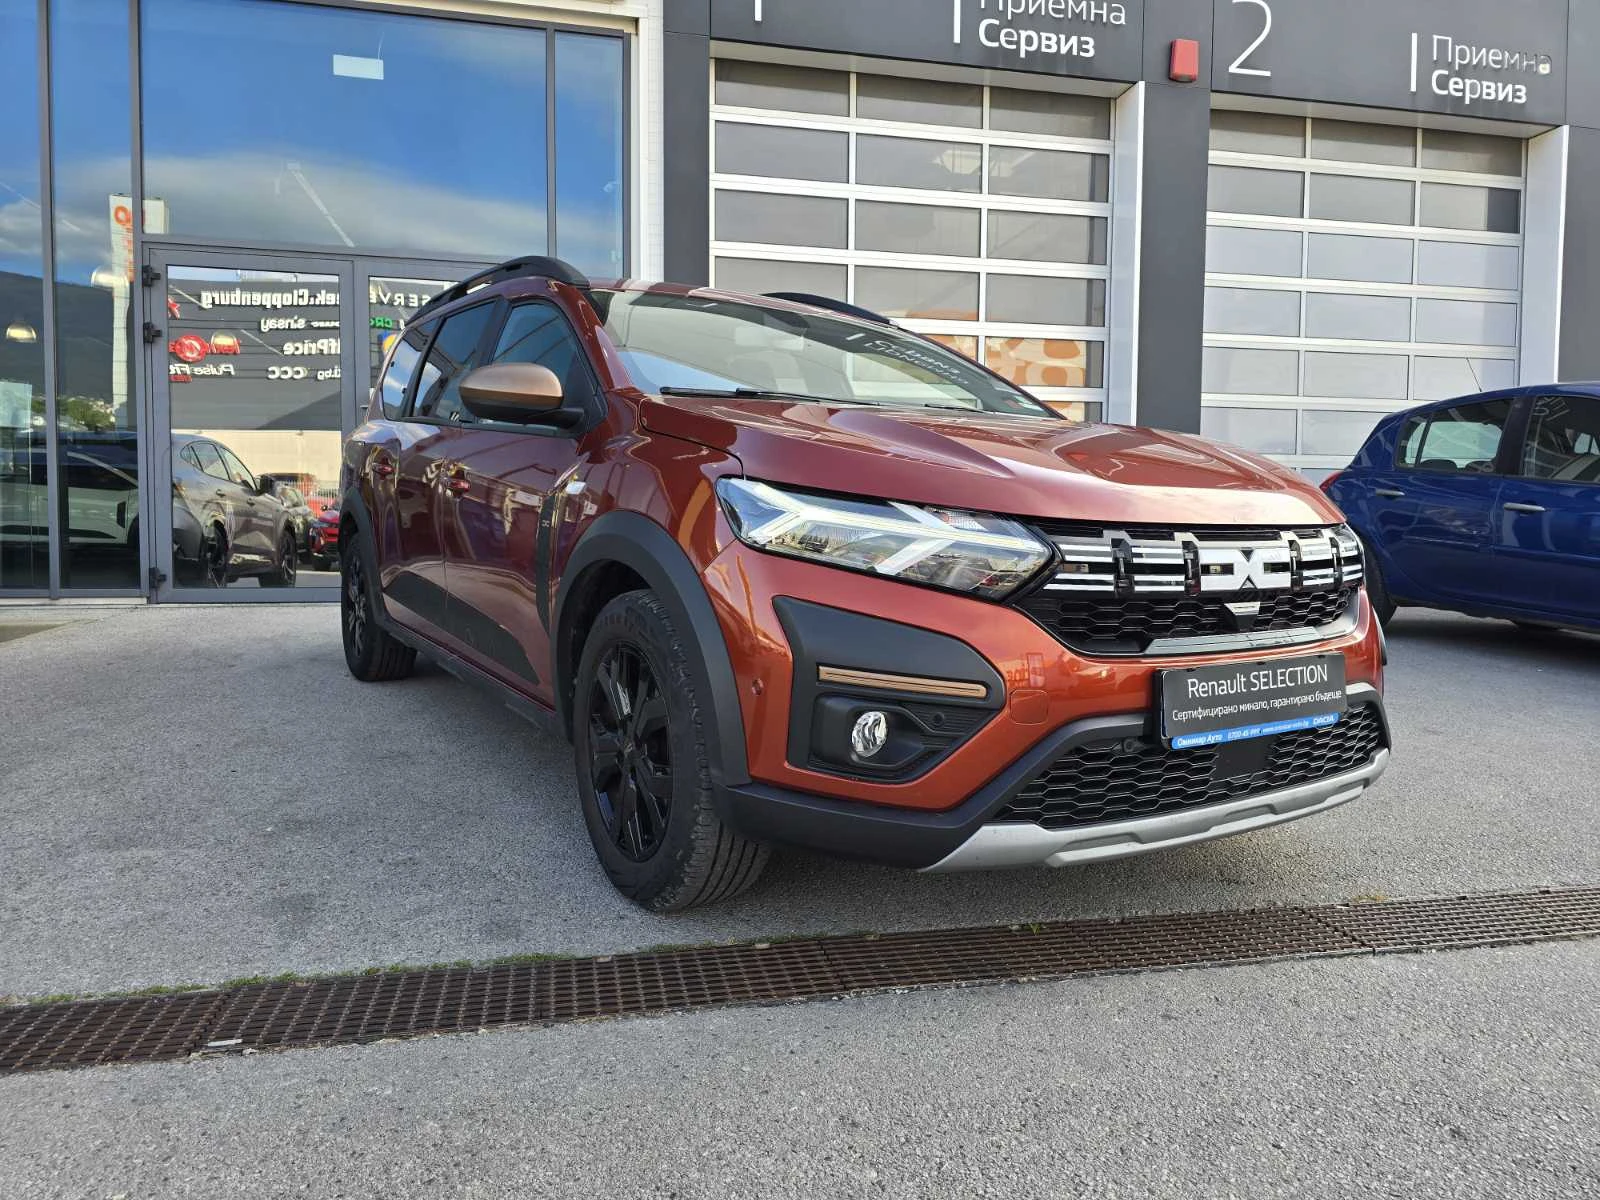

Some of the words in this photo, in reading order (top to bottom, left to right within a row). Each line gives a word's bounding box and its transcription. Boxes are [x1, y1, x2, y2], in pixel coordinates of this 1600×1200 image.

[978, 18, 1096, 58] Сервиз
[1228, 0, 1272, 77] 2
[1431, 69, 1528, 104] Сервиз
[1187, 672, 1247, 698] Renault
[1250, 664, 1328, 691] SELECTION
[1172, 704, 1238, 722] Сертифицирано
[1270, 693, 1315, 709] гарантирано
